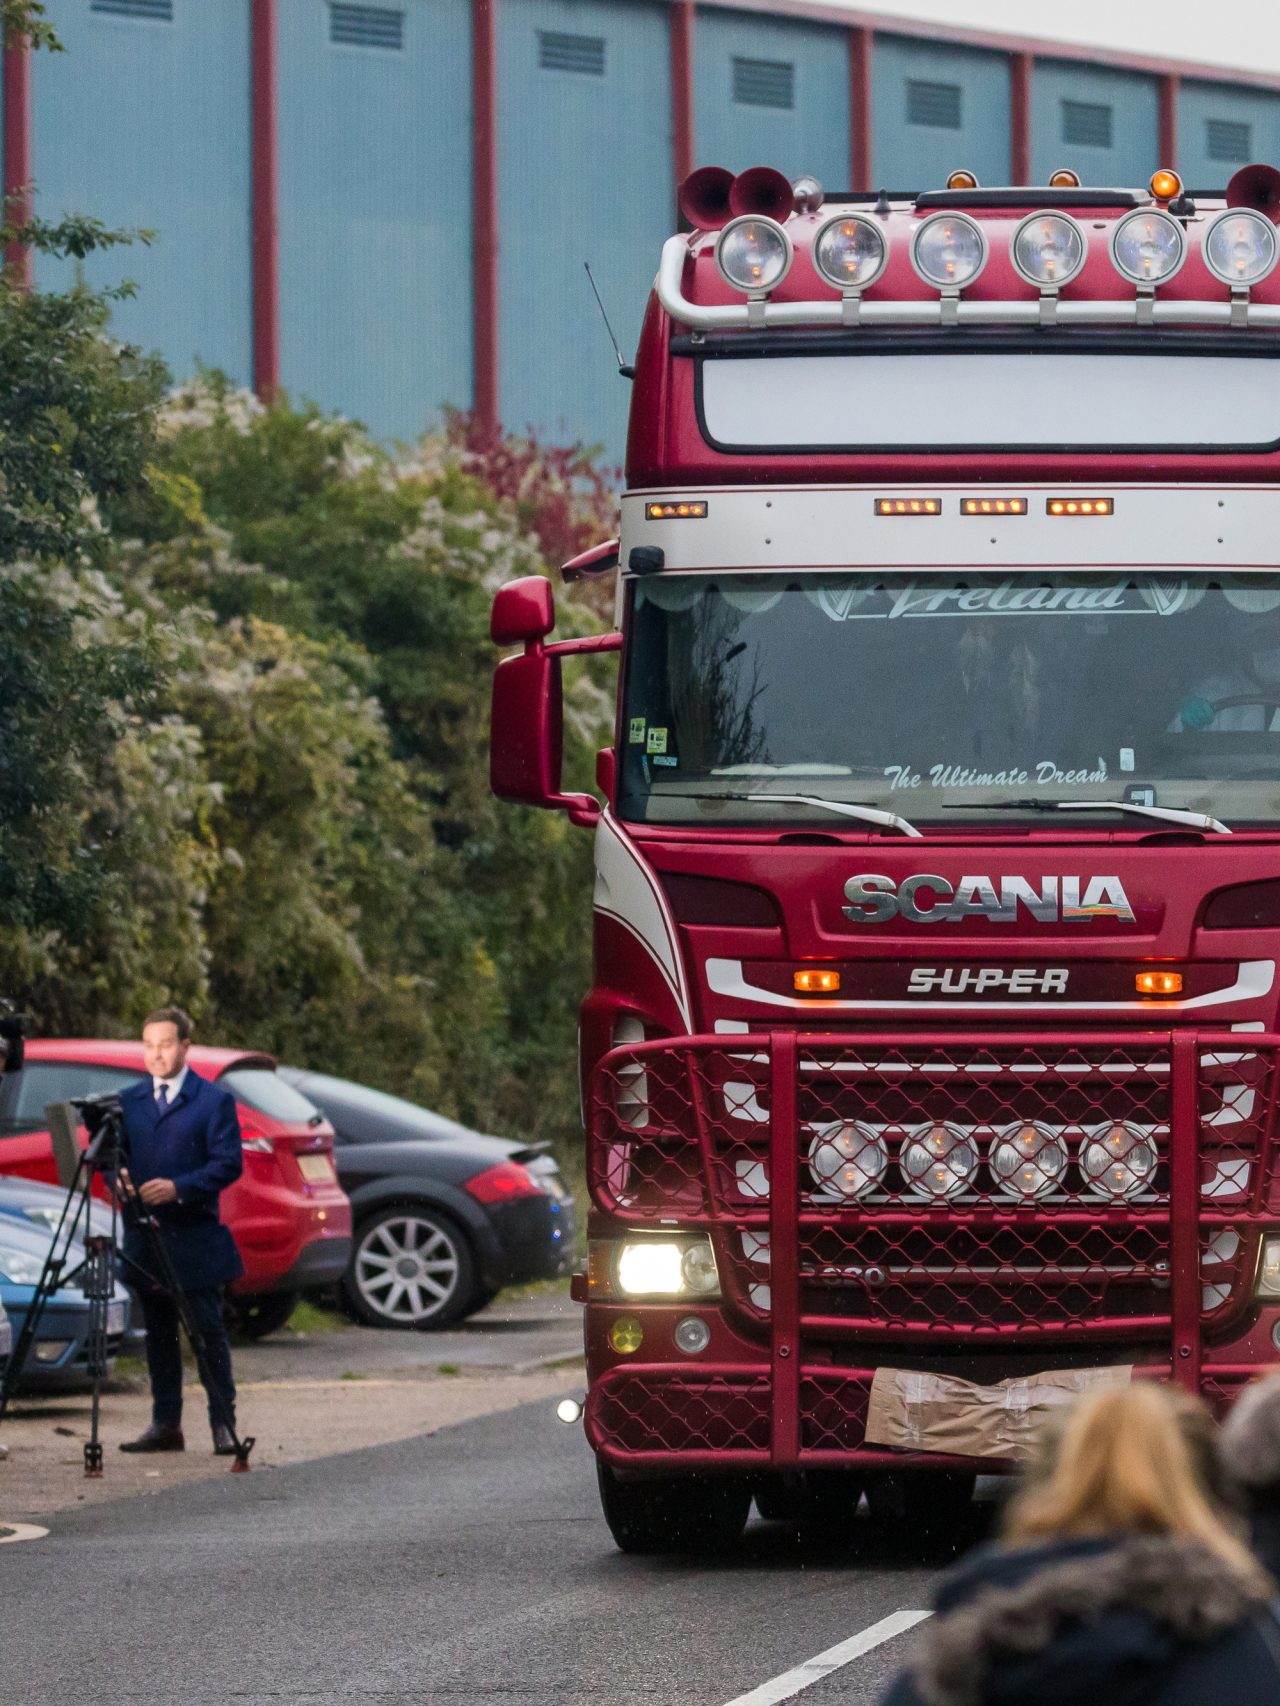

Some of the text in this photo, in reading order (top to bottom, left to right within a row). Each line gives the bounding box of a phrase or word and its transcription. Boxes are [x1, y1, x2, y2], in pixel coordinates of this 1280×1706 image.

[868, 577, 1131, 619] Ireland
[884, 760, 1108, 790] The Ultimate Dream
[842, 873, 1136, 923] SCANIA
[907, 968, 1069, 994] SUPER
